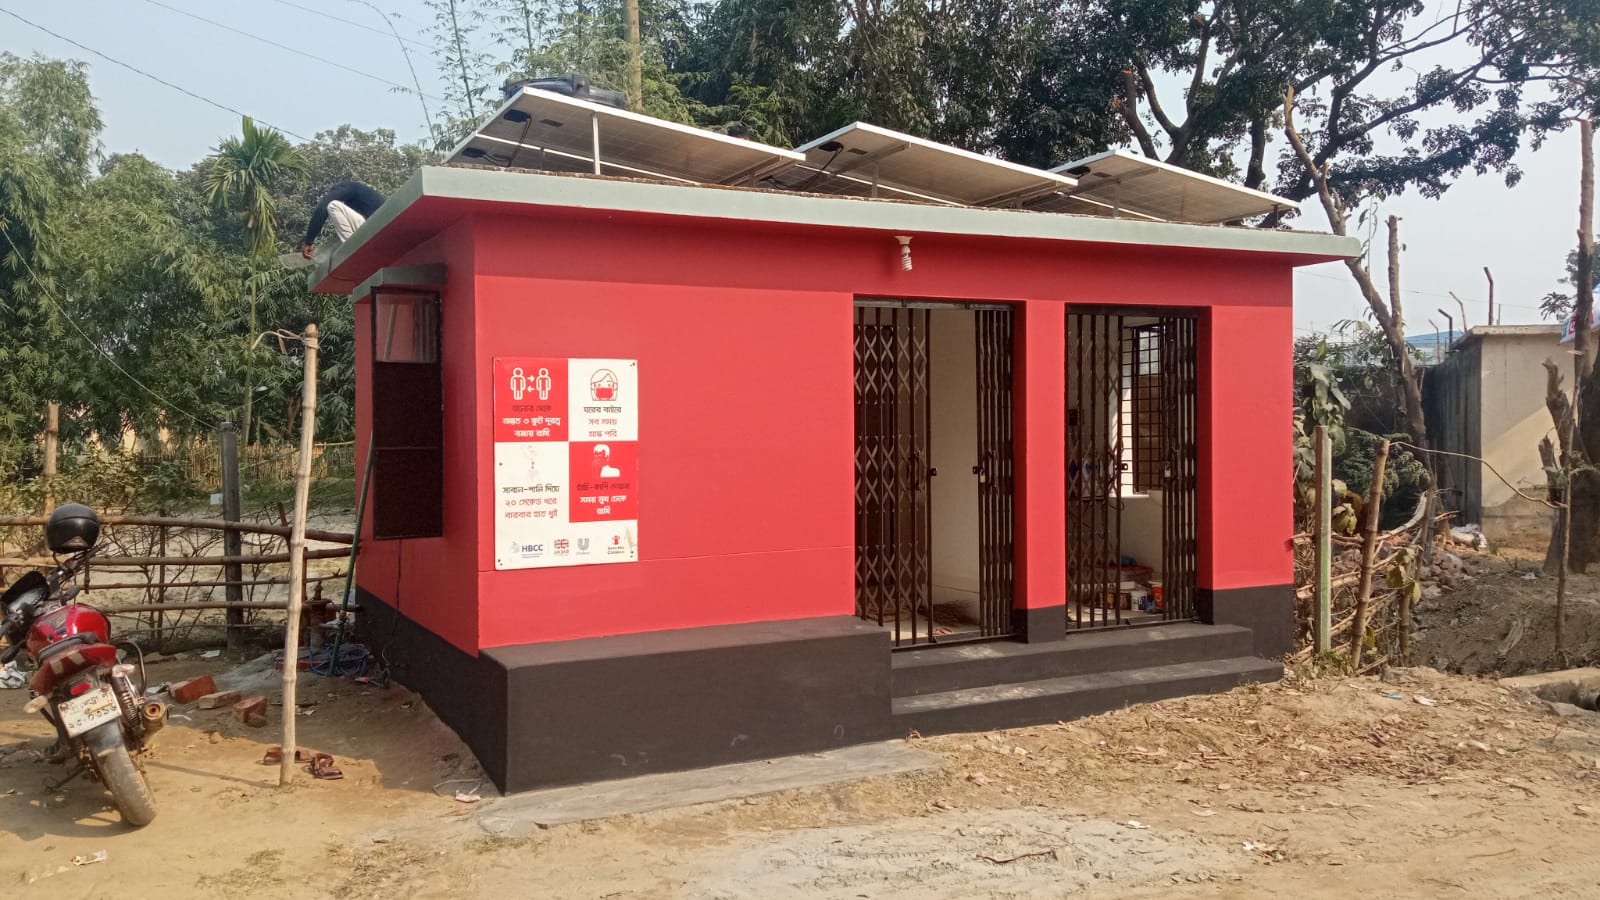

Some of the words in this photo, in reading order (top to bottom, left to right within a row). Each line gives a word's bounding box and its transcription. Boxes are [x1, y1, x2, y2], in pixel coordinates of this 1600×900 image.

[602, 404, 622, 413] বাইরে
[530, 416, 544, 426] ফুট
[535, 428, 551, 437] রাখি
[605, 428, 617, 437] পরি
[502, 483, 544, 493] সাবান-পানি
[544, 483, 560, 492] দিয়ে
[505, 499, 517, 507] ২০
[598, 496, 609, 504] মুখ
[611, 495, 626, 503] ঢেকে
[505, 511, 532, 519] বারবার
[533, 510, 547, 518] হাত
[548, 509, 559, 519] ধুই
[596, 506, 611, 515] রাখি
[521, 544, 544, 552] HBCC
